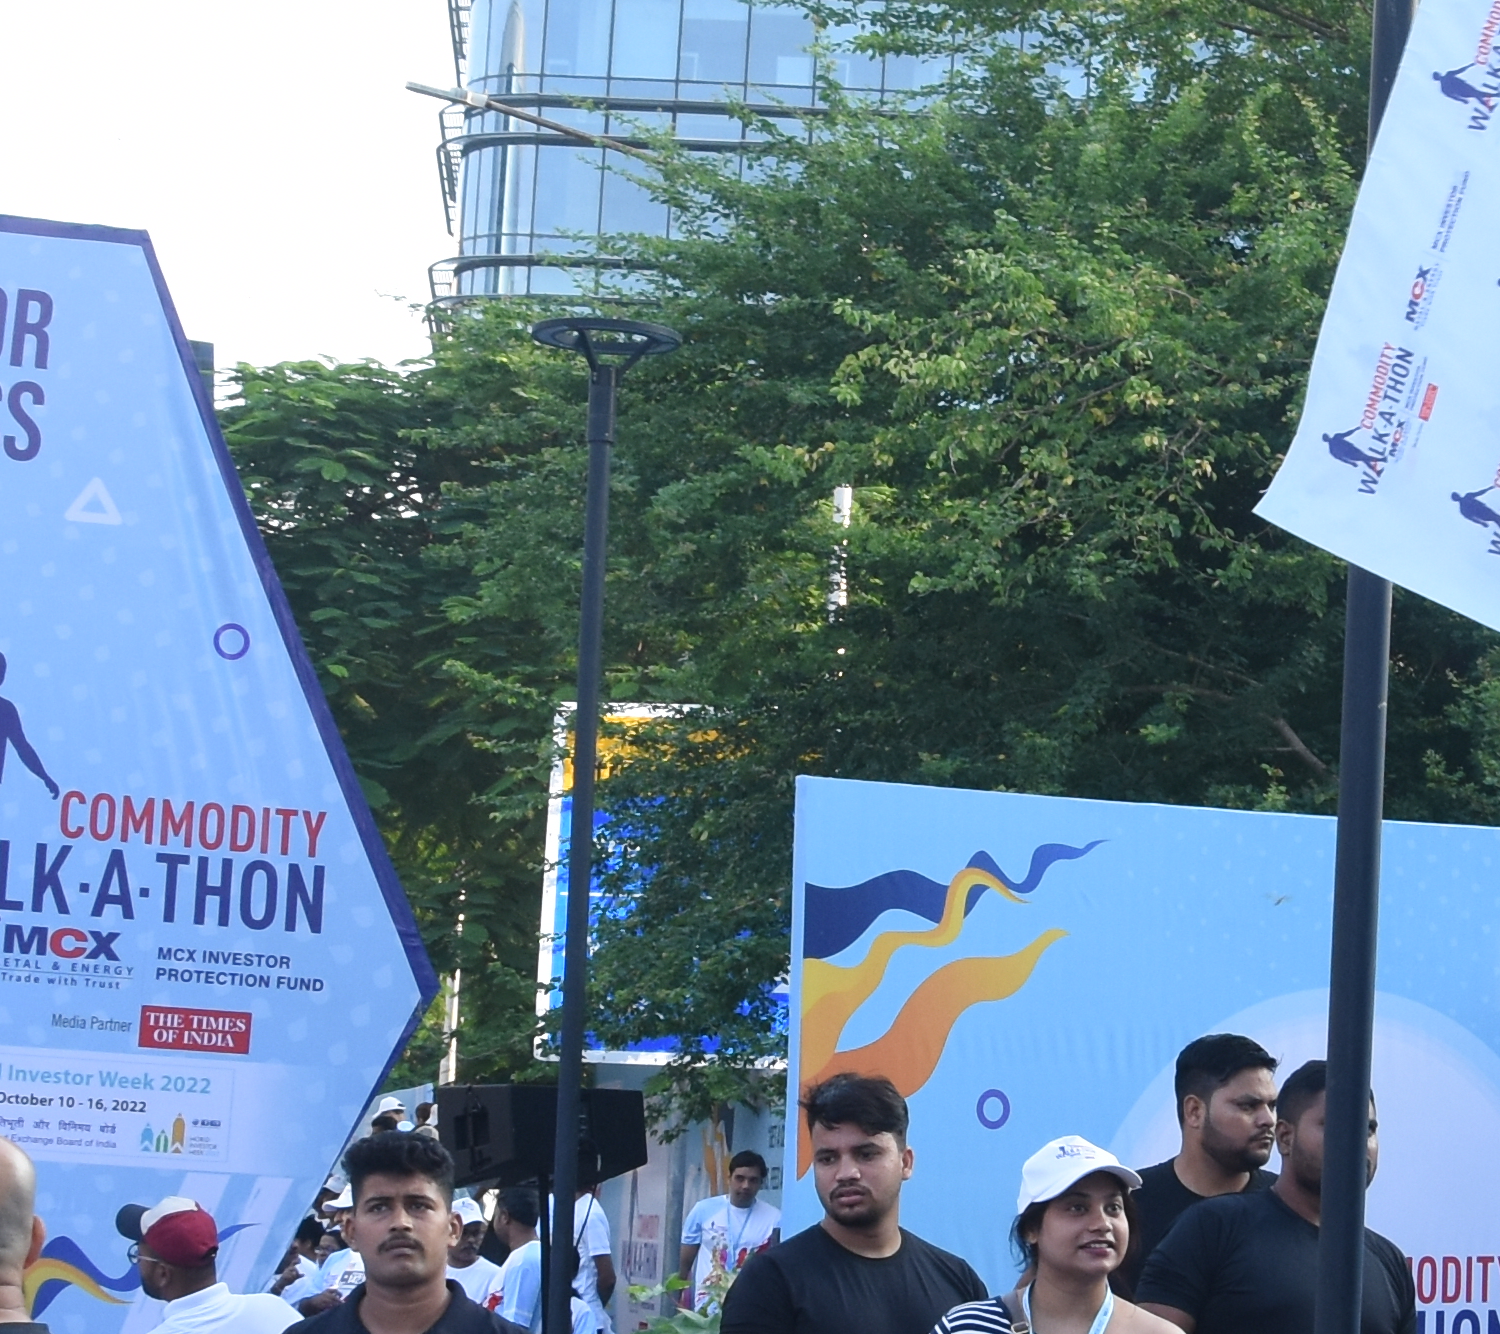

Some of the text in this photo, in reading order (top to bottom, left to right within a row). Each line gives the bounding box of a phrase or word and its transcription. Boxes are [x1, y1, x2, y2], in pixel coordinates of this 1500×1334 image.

[1405, 263, 1432, 324] MCX
[1361, 341, 1398, 430] COMMODITY
[59, 790, 328, 859] COMMODITY
[2, 923, 122, 963] MCX
[157, 946, 292, 970] MCX INVESTOR
[1, 971, 121, 991] Trade with Trust
[71, 962, 135, 978] ENERGY
[155, 967, 325, 993] PROTECTION FUND
[51, 1013, 133, 1034] Media Partner
[146, 1011, 247, 1033] THE TIMES
[153, 1028, 235, 1048] OF INDIA
[7, 1064, 94, 1087] Investor
[99, 1069, 155, 1091] Week
[160, 1074, 212, 1095] 2022
[58, 1095, 75, 1109] 10
[87, 1097, 108, 1113] 16,
[112, 1098, 148, 1114] 2022
[11, 1133, 54, 1147] Exchange
[56, 1135, 82, 1148] Board
[95, 1138, 117, 1149] India
